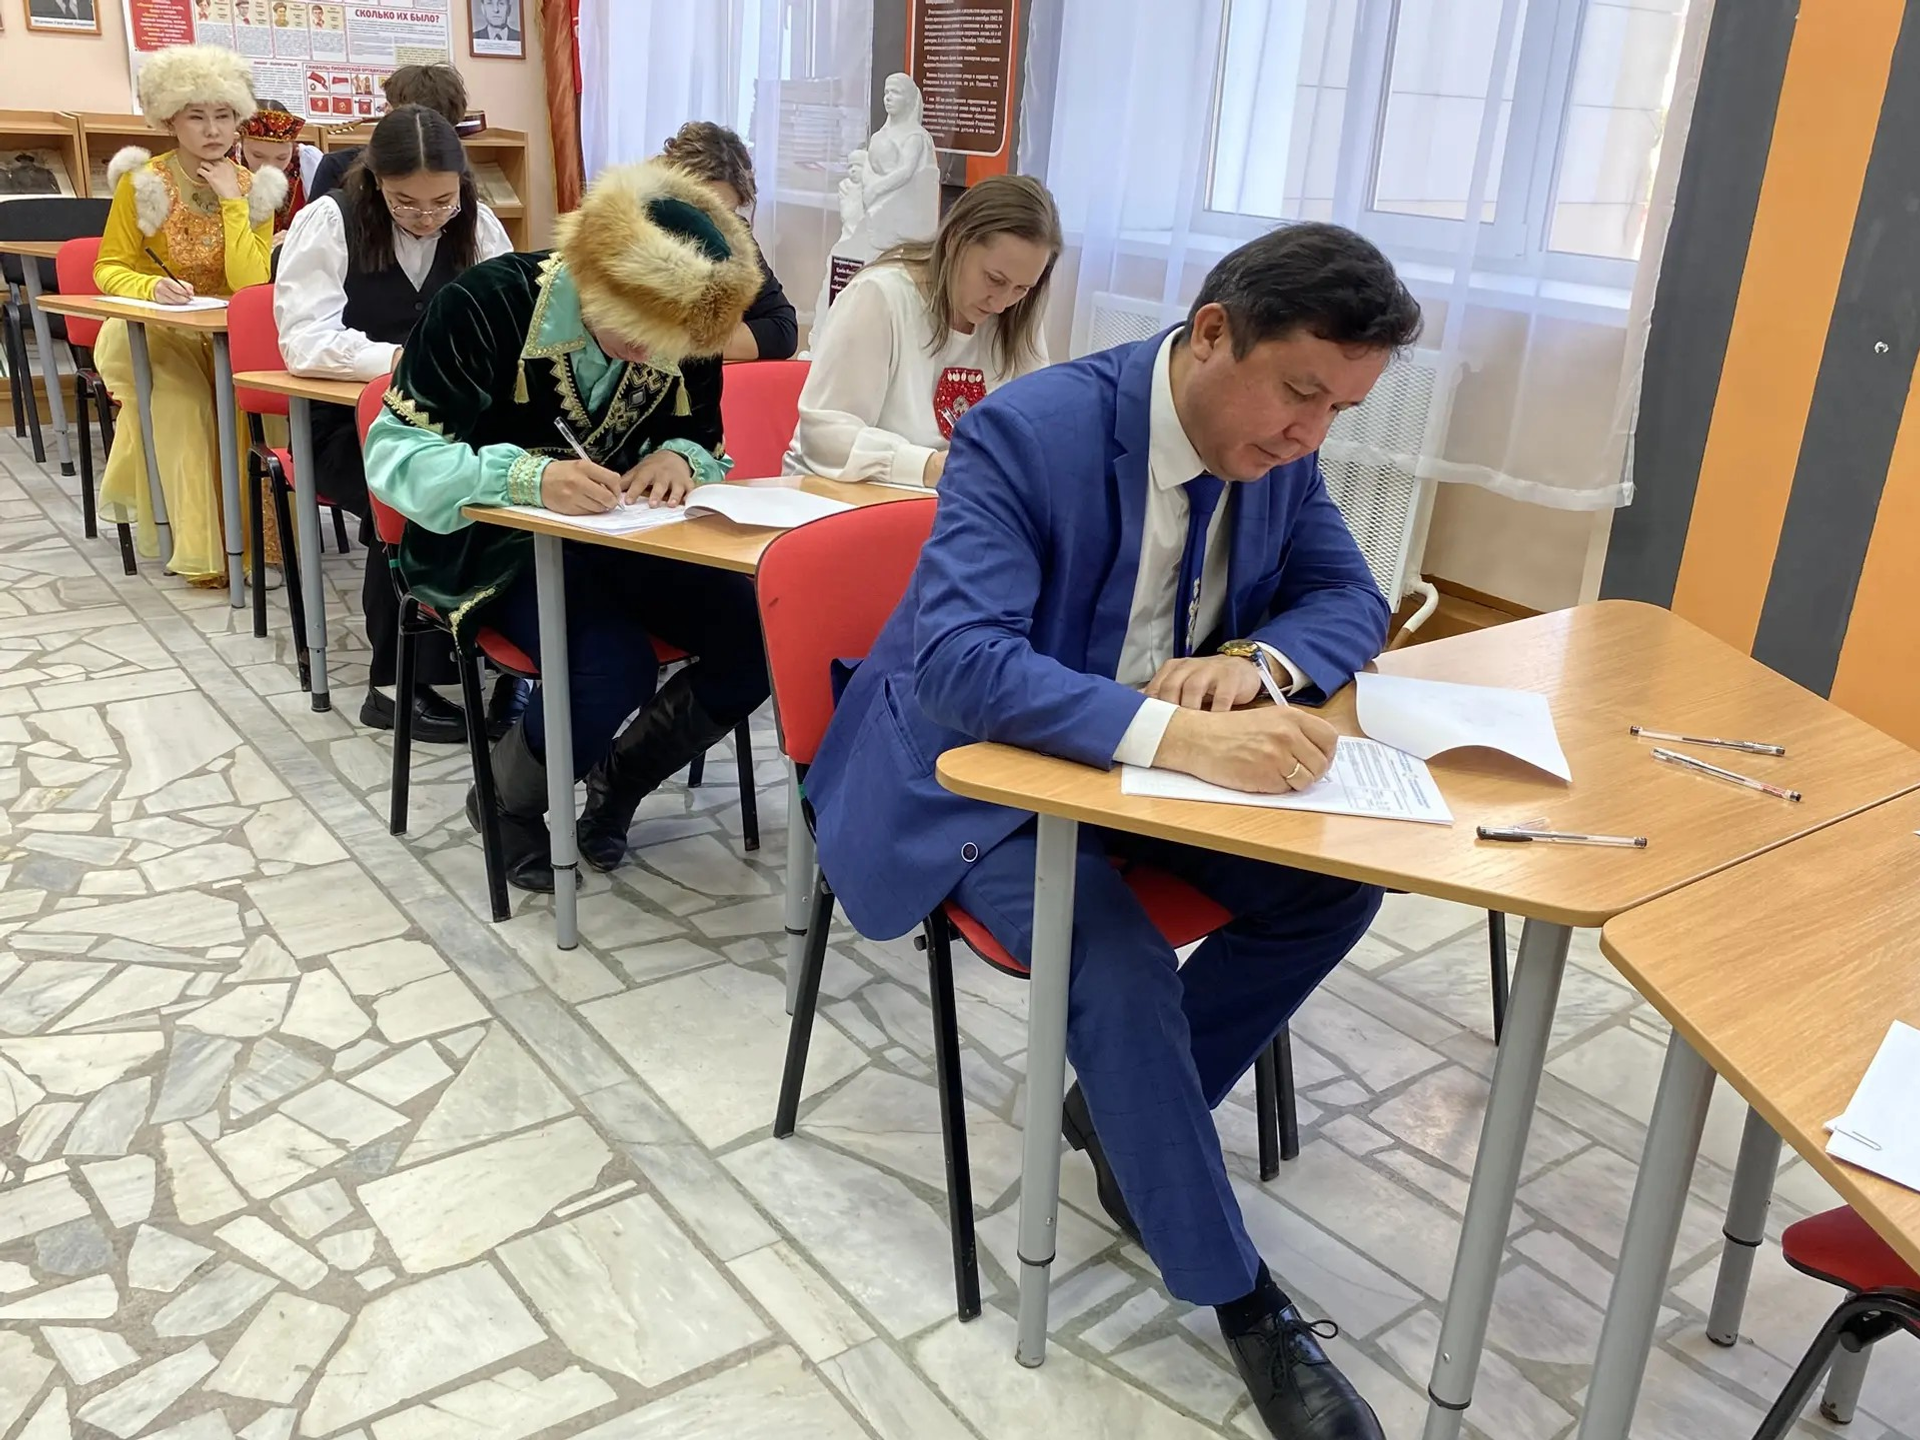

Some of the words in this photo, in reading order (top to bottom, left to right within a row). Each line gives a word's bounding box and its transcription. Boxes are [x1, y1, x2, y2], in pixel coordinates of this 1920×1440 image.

[355, 9, 395, 20] СКОЛЬКО
[397, 12, 409, 20] ИХ
[410, 13, 440, 23] БЫЛО?
